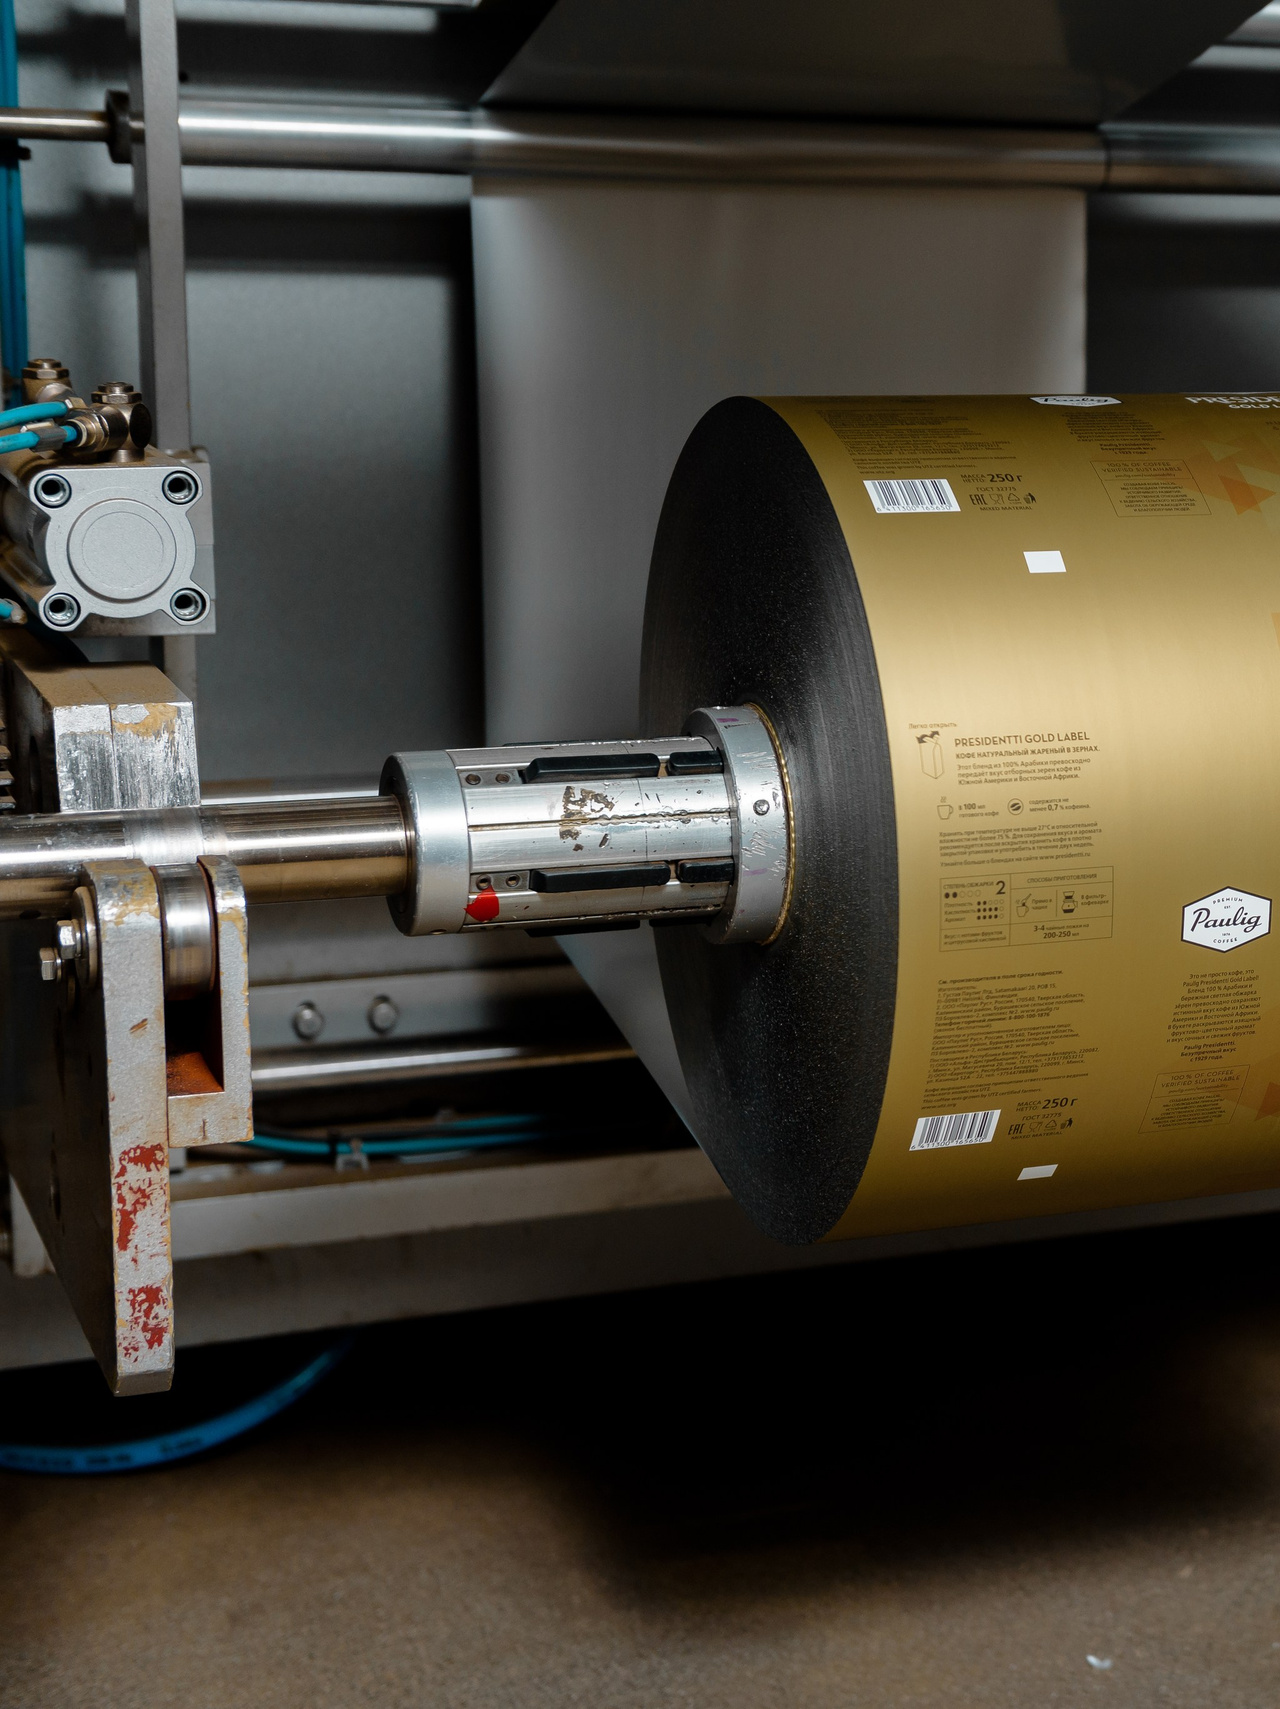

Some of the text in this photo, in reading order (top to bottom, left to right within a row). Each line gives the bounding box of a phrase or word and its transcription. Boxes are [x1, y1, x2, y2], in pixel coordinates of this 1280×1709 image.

[987, 472, 1014, 483] 250
[1016, 474, 1023, 482] г
[954, 731, 1090, 748] PRESIDENTTI GOLD LABEL
[956, 752, 976, 760] КОФЕ
[976, 748, 1029, 758] НАТУРАЛЬНЫЙ
[1030, 746, 1066, 756] ЖАРЕНЫЙ
[1002, 760, 1020, 768] 100%
[1020, 760, 1049, 768] Арабики
[1050, 758, 1091, 766] превосходно
[1056, 766, 1072, 774] кофе
[963, 802, 976, 810] 100
[1054, 873, 1098, 882] ПРИГОТОВЛЕНИЯ
[995, 880, 1006, 896] 2
[1212, 896, 1244, 905] PREMIUM
[1190, 906, 1263, 934] Paulig
[1033, 924, 1046, 932] 3-4
[1043, 930, 1072, 940] 200-250
[1212, 936, 1239, 944] COFFEE
[1206, 1069, 1234, 1078] COFFEE
[1161, 1074, 1240, 1088] VERIFIED SUSTAINABLE
[1042, 1097, 1069, 1110] 250
[1070, 1098, 1079, 1106] г
